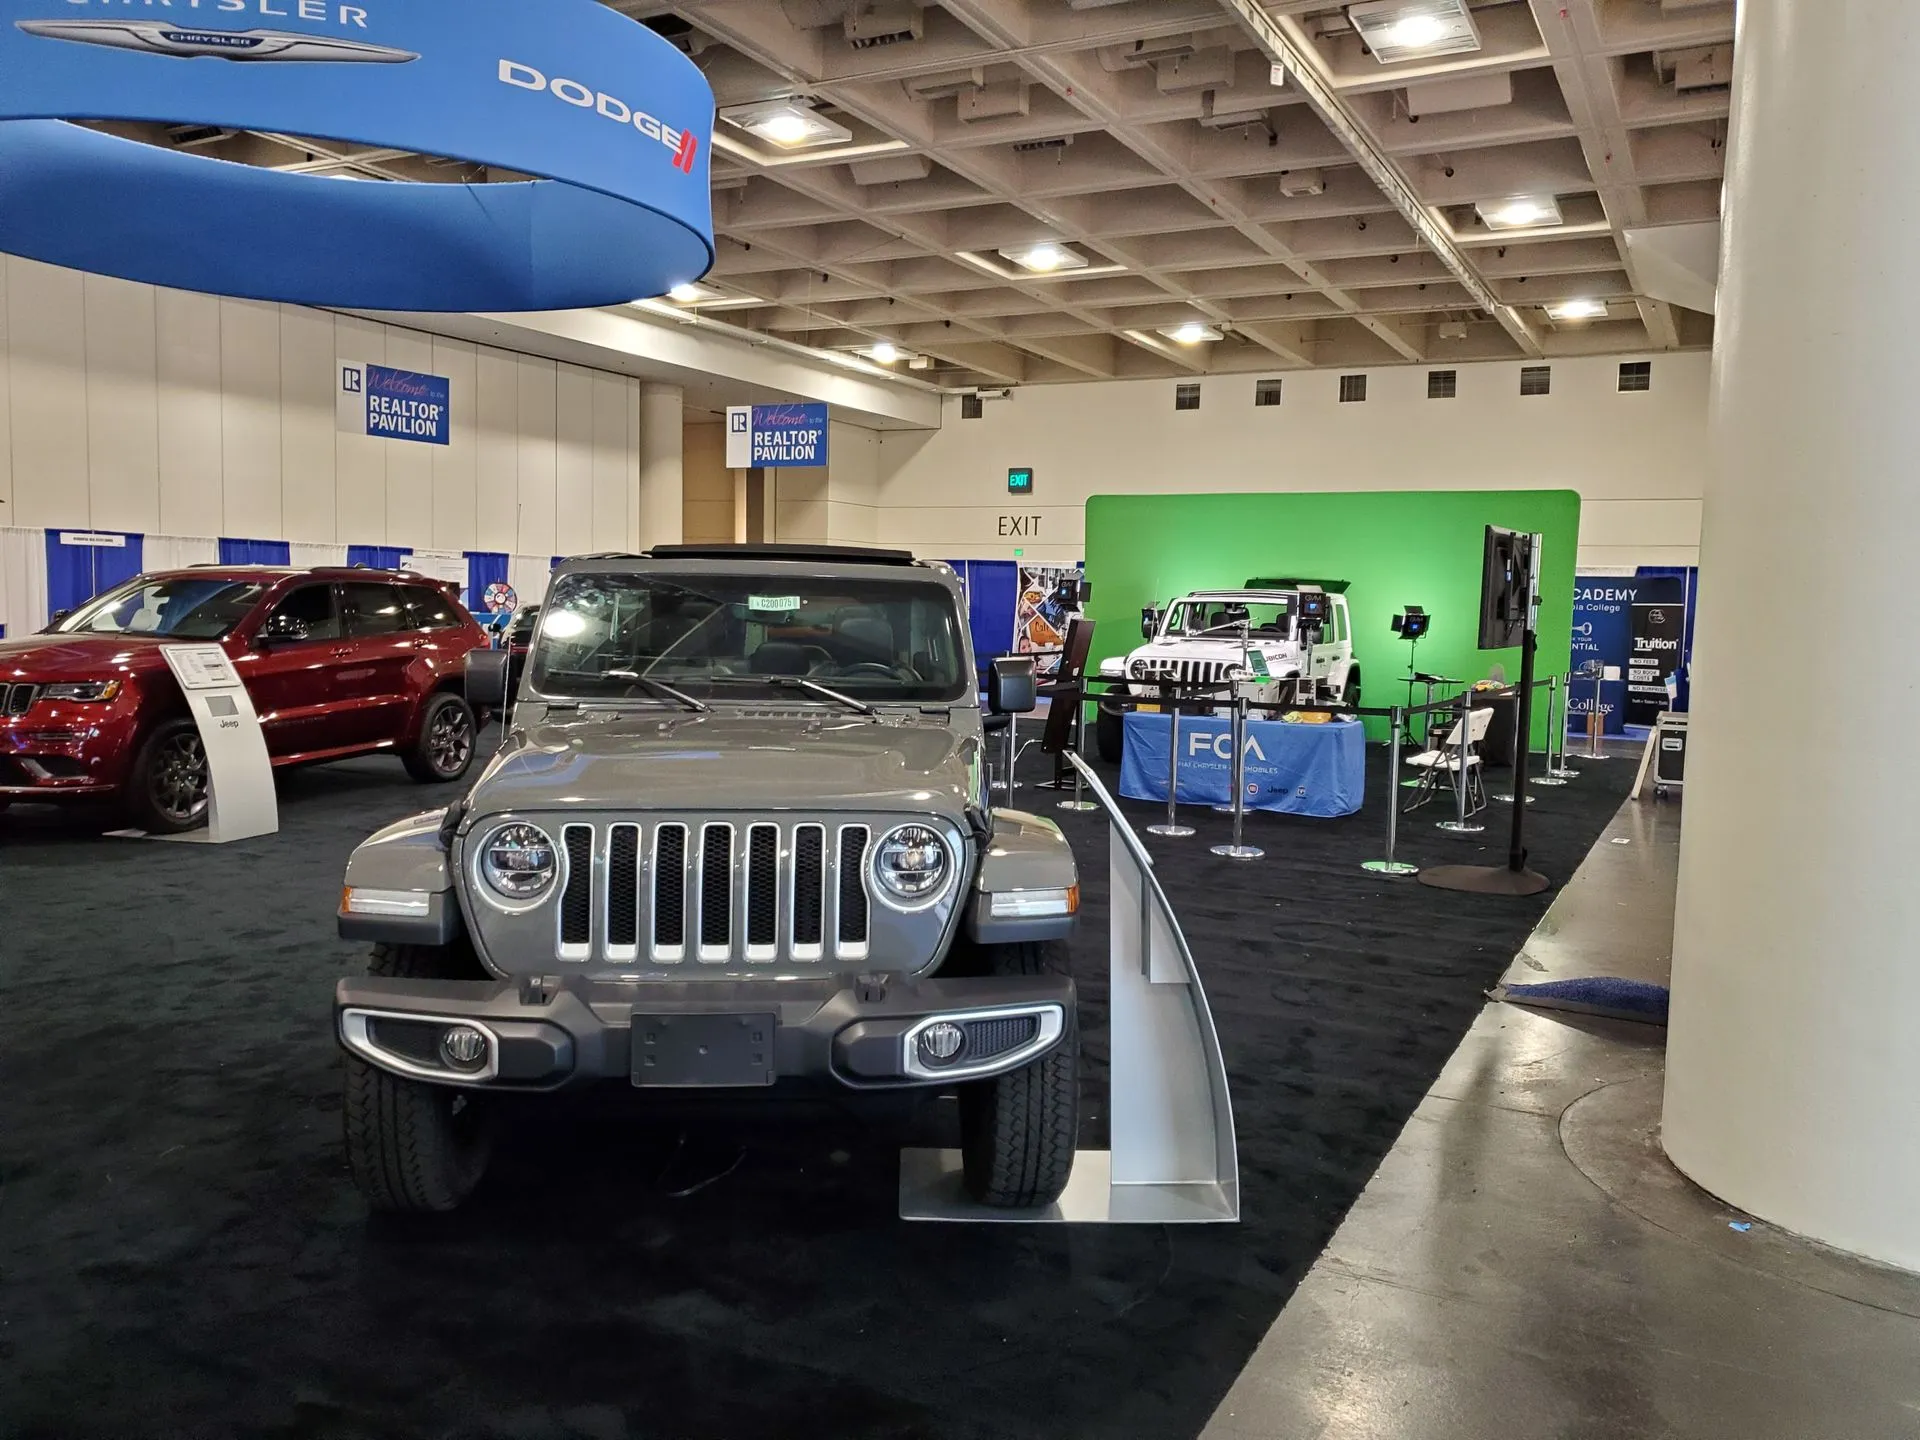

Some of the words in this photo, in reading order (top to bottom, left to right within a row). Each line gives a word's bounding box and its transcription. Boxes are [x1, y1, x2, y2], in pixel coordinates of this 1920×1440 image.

[66, 0, 367, 28] SLER
[170, 34, 250, 45] CHRYSLER
[499, 59, 682, 155] DODGE
[367, 368, 427, 396] Welcome
[753, 403, 806, 426] Welcome
[370, 412, 437, 437] PAVILION
[754, 445, 815, 461] PAVILION
[1009, 474, 1029, 486] EXIT
[998, 515, 1042, 536] EXIT
[1573, 588, 1637, 601] CADEMY
[1586, 603, 1621, 614] College
[1634, 637, 1677, 651] Truition
[1568, 698, 1614, 714] Collge
[1267, 786, 1289, 795] Jeep
